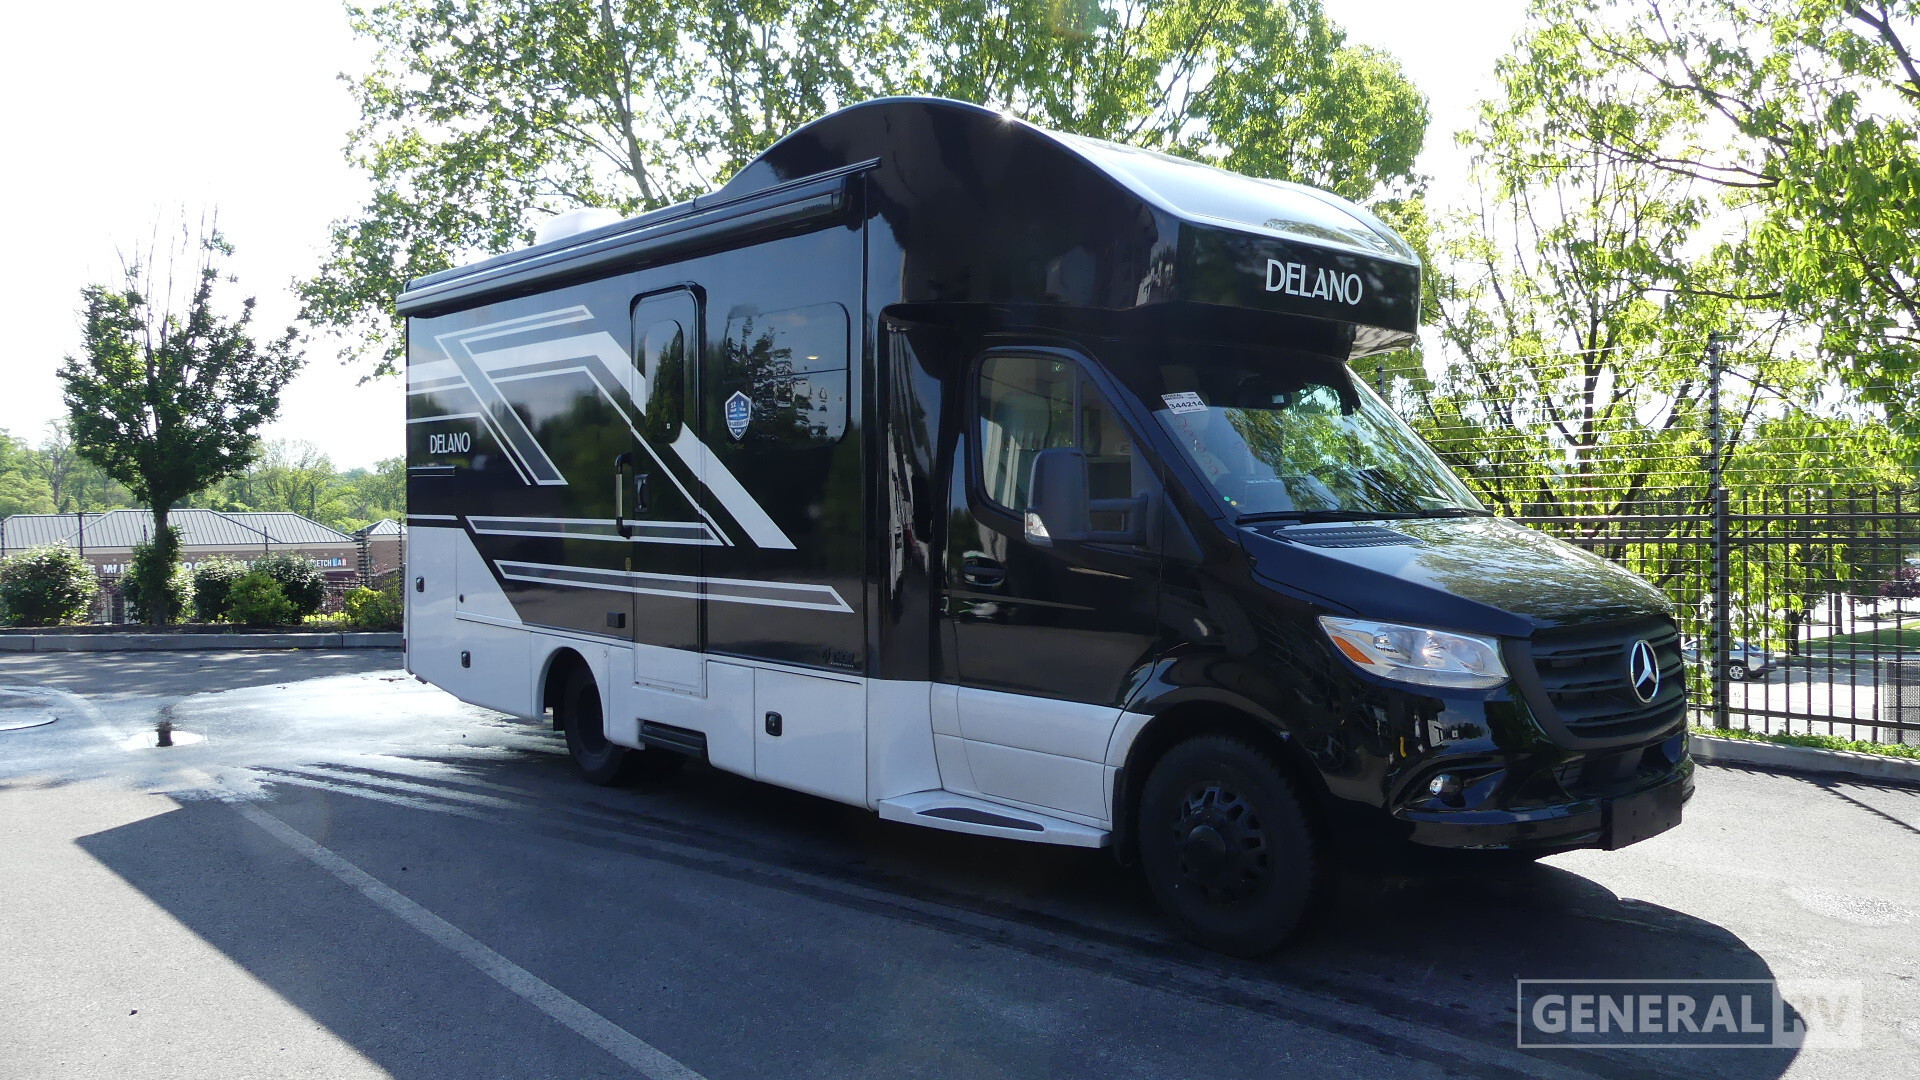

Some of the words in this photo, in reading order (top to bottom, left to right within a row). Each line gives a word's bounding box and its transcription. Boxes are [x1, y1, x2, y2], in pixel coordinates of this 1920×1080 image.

[1265, 258, 1363, 306] DELANO
[1169, 400, 1204, 409] 344214
[429, 431, 471, 454] DELANO
